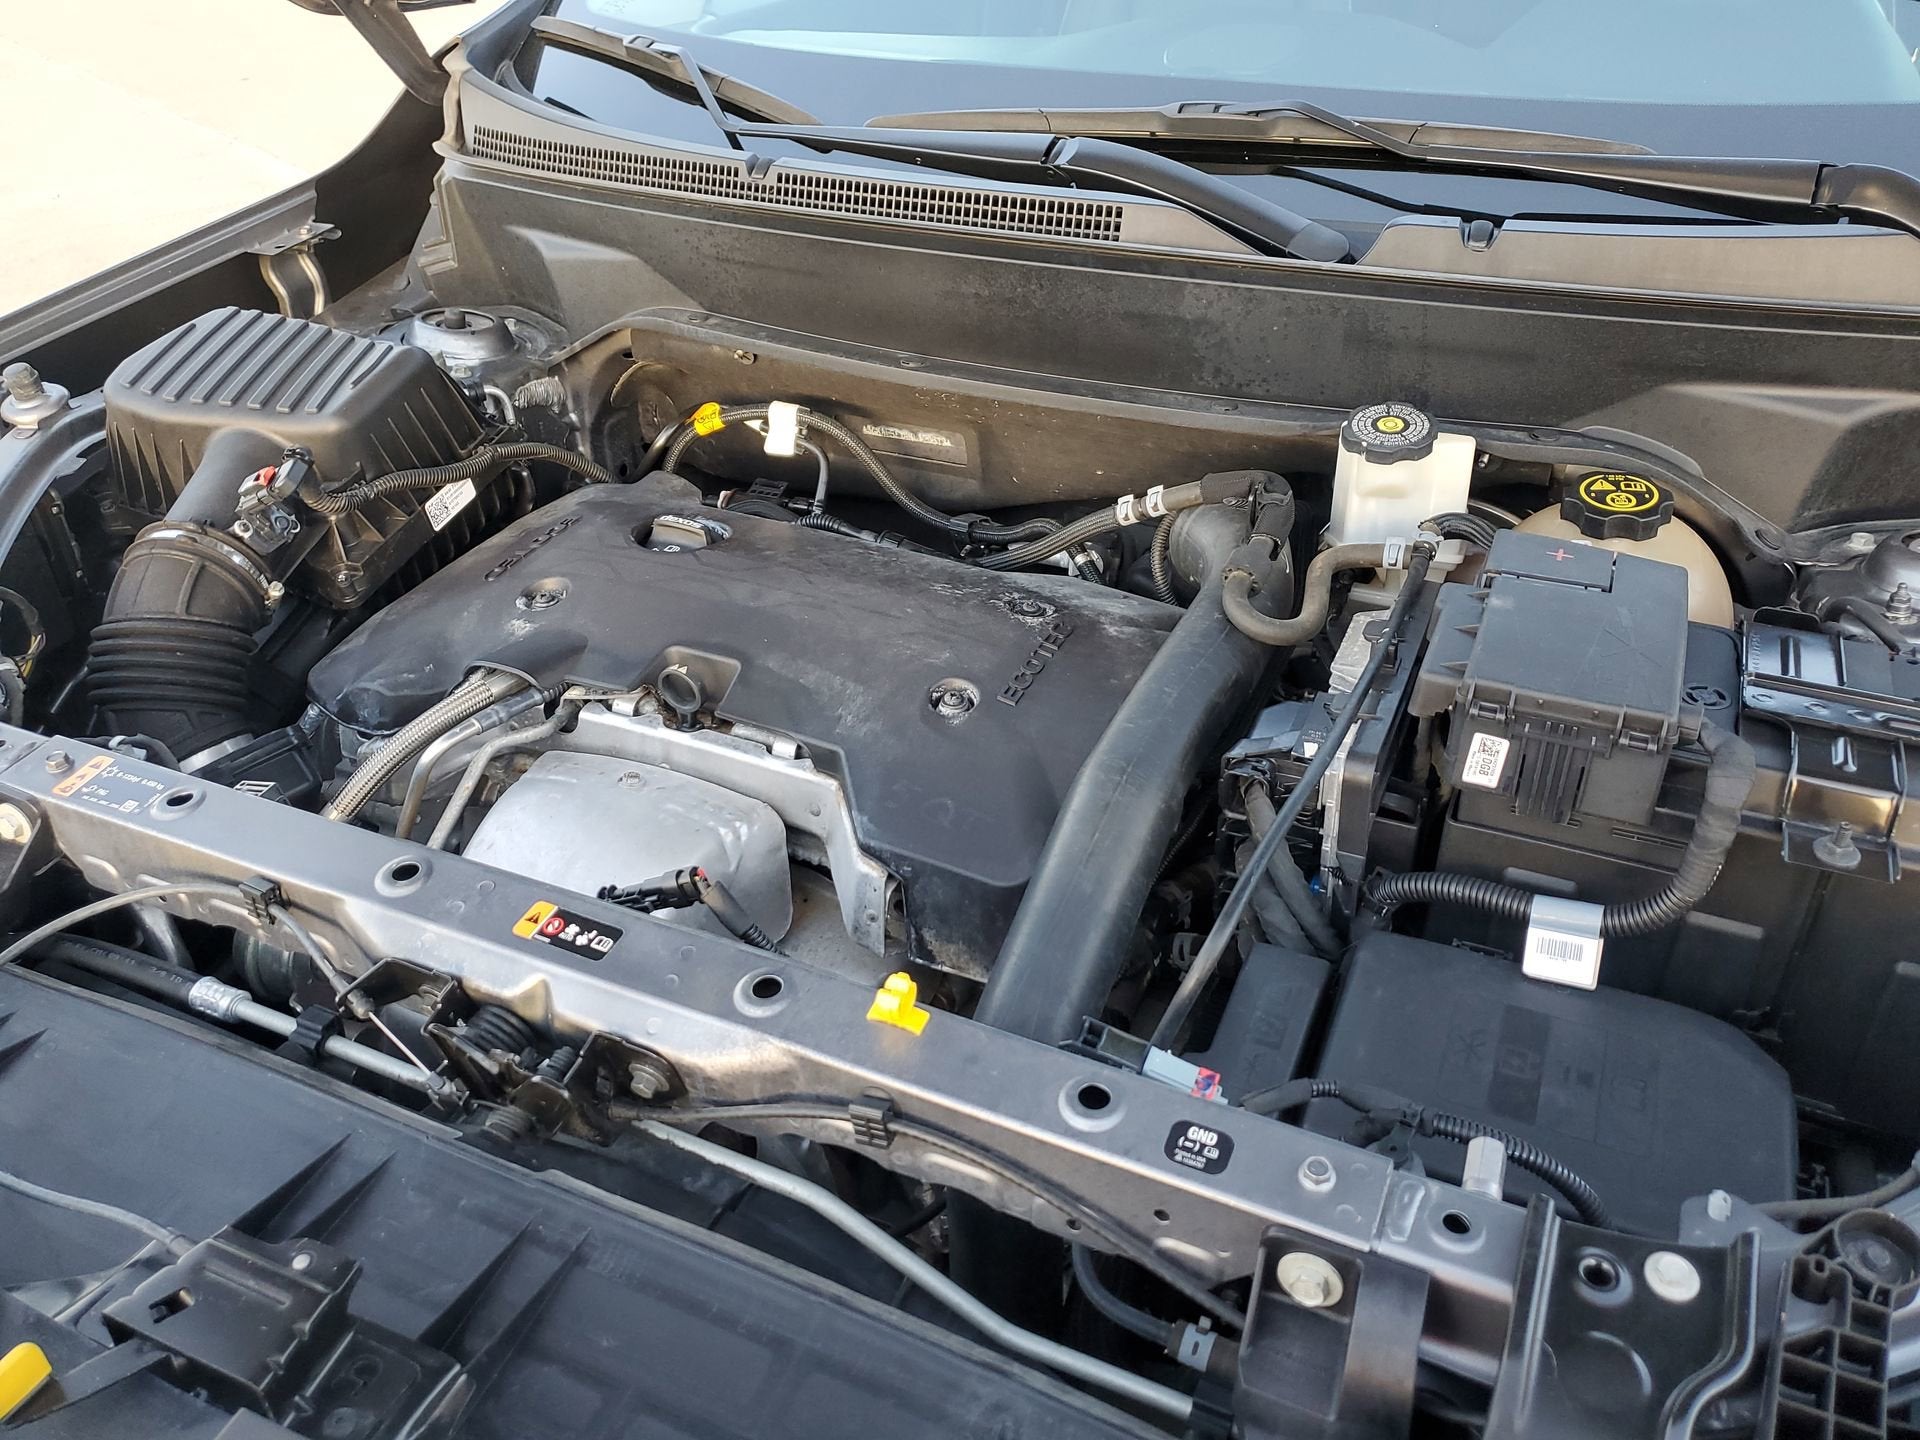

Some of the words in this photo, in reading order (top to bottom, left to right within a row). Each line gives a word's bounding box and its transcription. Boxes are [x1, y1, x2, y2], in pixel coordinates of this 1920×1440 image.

[660, 514, 703, 529] dexos
[996, 620, 1074, 707] ECOTEC
[1186, 1126, 1219, 1147] GND
